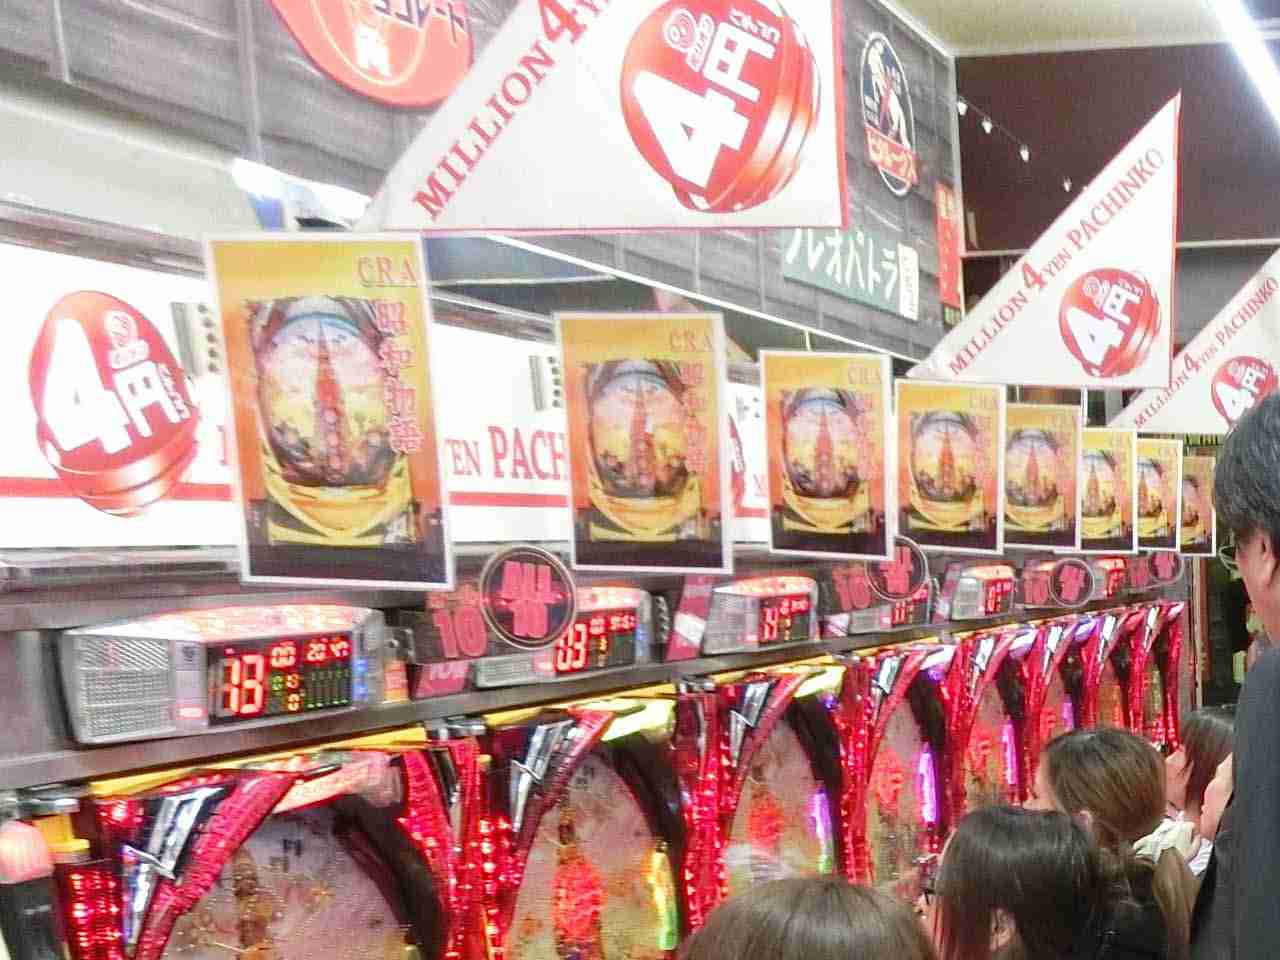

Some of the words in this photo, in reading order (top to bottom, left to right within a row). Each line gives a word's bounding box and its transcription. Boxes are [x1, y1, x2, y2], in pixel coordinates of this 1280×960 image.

[412, 40, 556, 222] MILLION
[538, 0, 587, 44] 4
[632, 21, 775, 190] 4円
[358, 257, 418, 286] CRA
[949, 290, 1030, 375] MILLION
[1022, 262, 1046, 291] 4
[1043, 249, 1073, 279] YEN
[1066, 148, 1164, 249] PACHINKO
[1065, 283, 1142, 365] 4円
[1184, 353, 1200, 374] 4
[1215, 277, 1279, 345] PACHINKO
[41, 318, 181, 455] 4円
